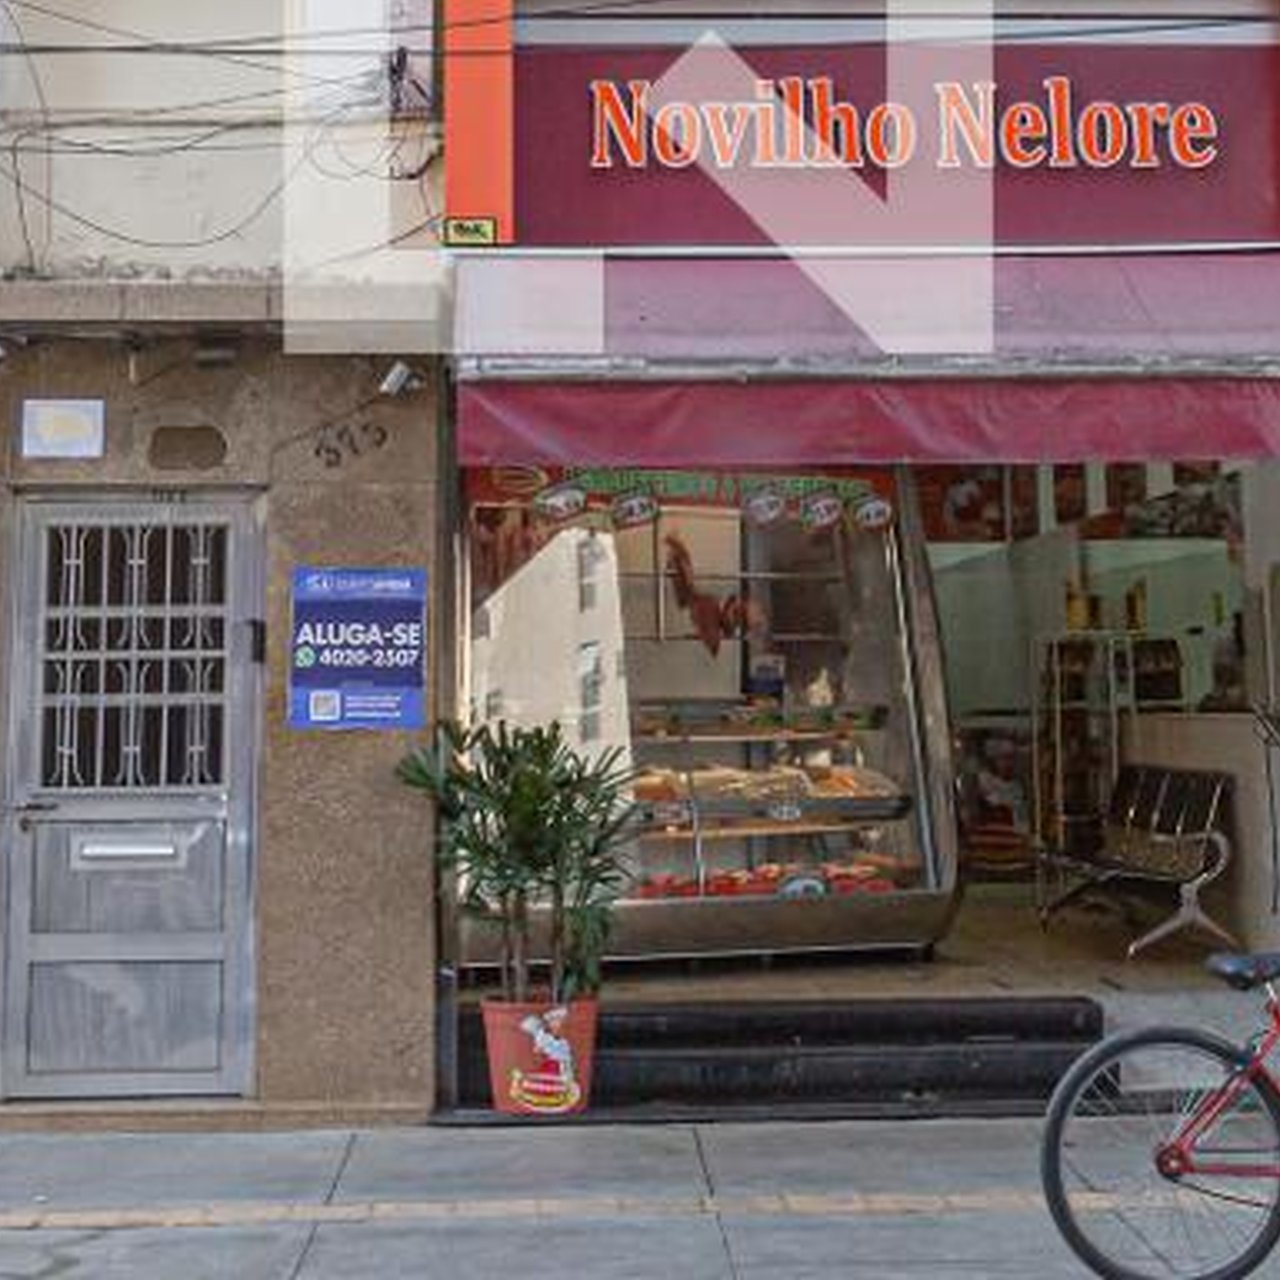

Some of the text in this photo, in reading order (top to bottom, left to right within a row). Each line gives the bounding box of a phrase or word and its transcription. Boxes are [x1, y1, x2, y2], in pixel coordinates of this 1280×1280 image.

[589, 76, 1220, 169] Novilho Nelore
[296, 622, 422, 646] ALUGA-SE
